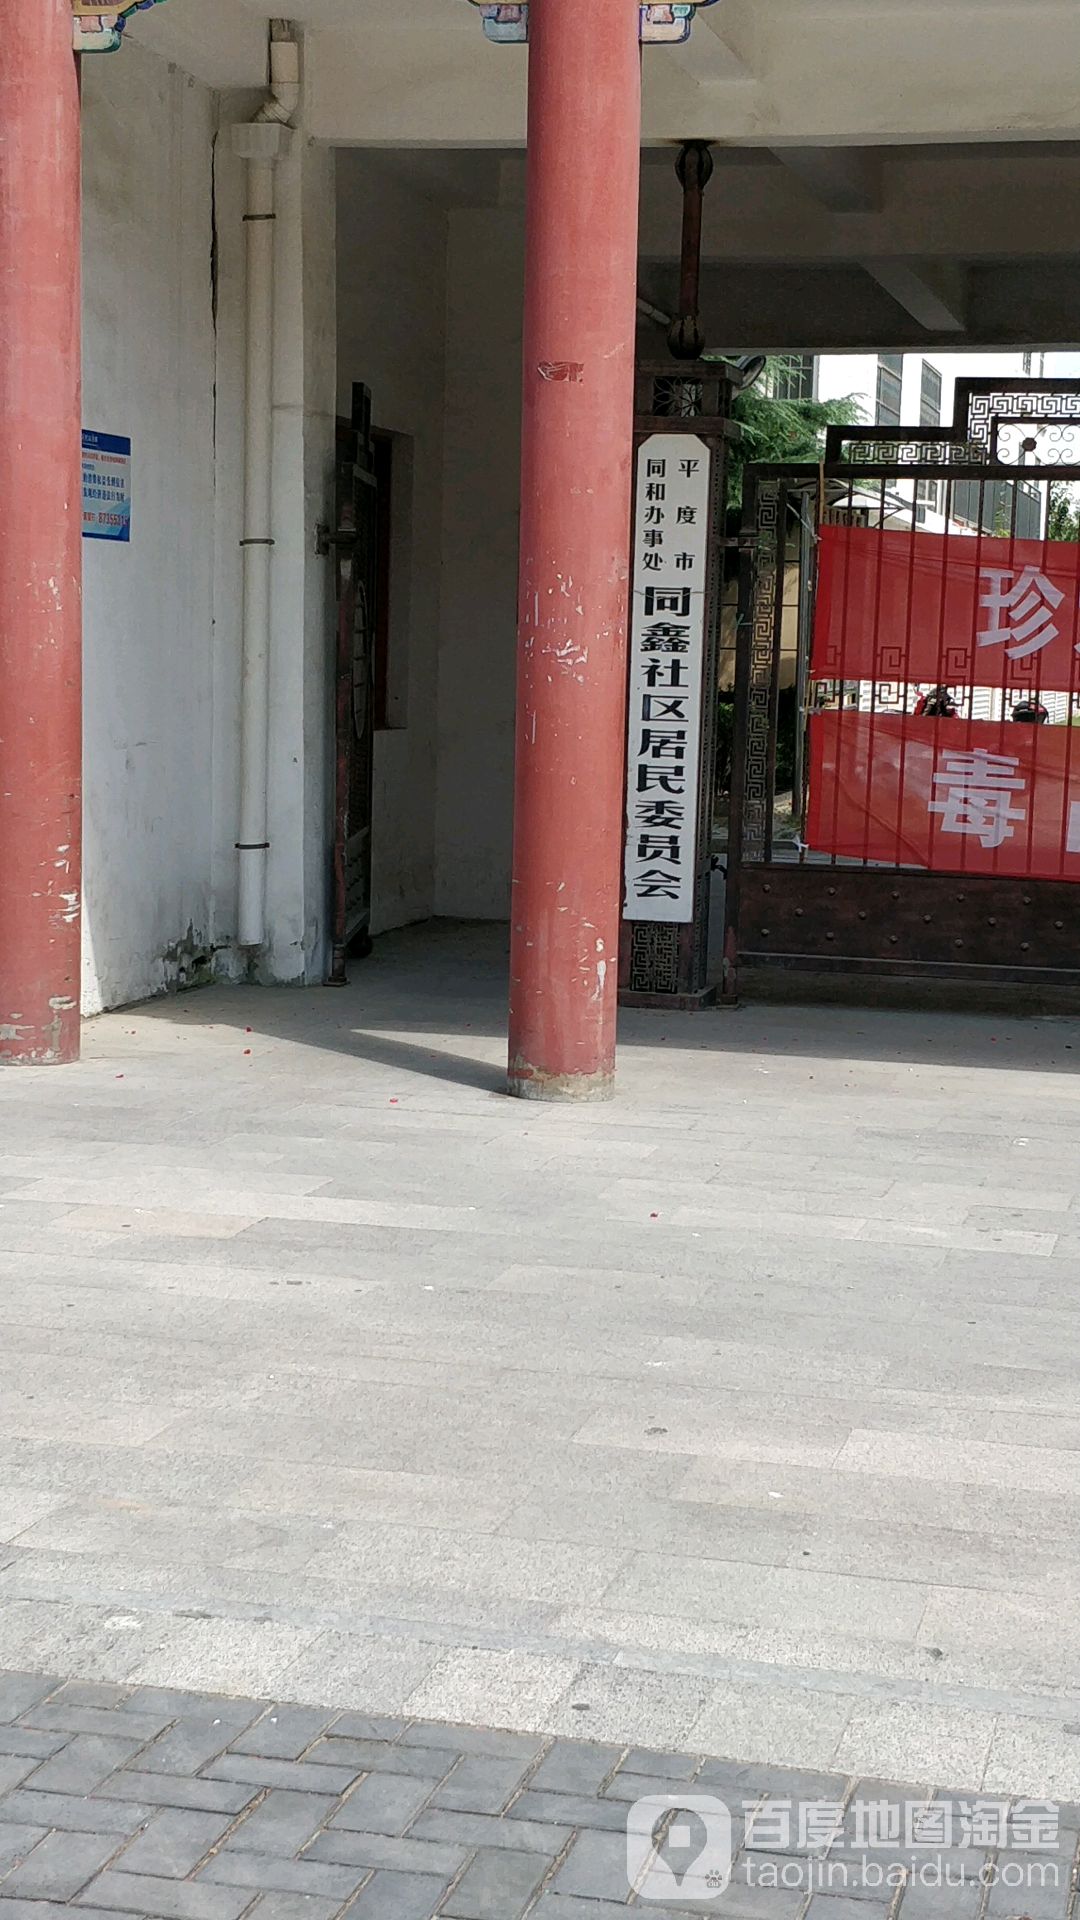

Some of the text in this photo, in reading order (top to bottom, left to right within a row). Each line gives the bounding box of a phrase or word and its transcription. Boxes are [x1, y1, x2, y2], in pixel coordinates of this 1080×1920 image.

[642, 458, 667, 571] 同和办事处
[673, 459, 700, 571] 平度市
[976, 565, 1080, 660] 珍
[633, 586, 692, 900] 同鑫社区居民委员会
